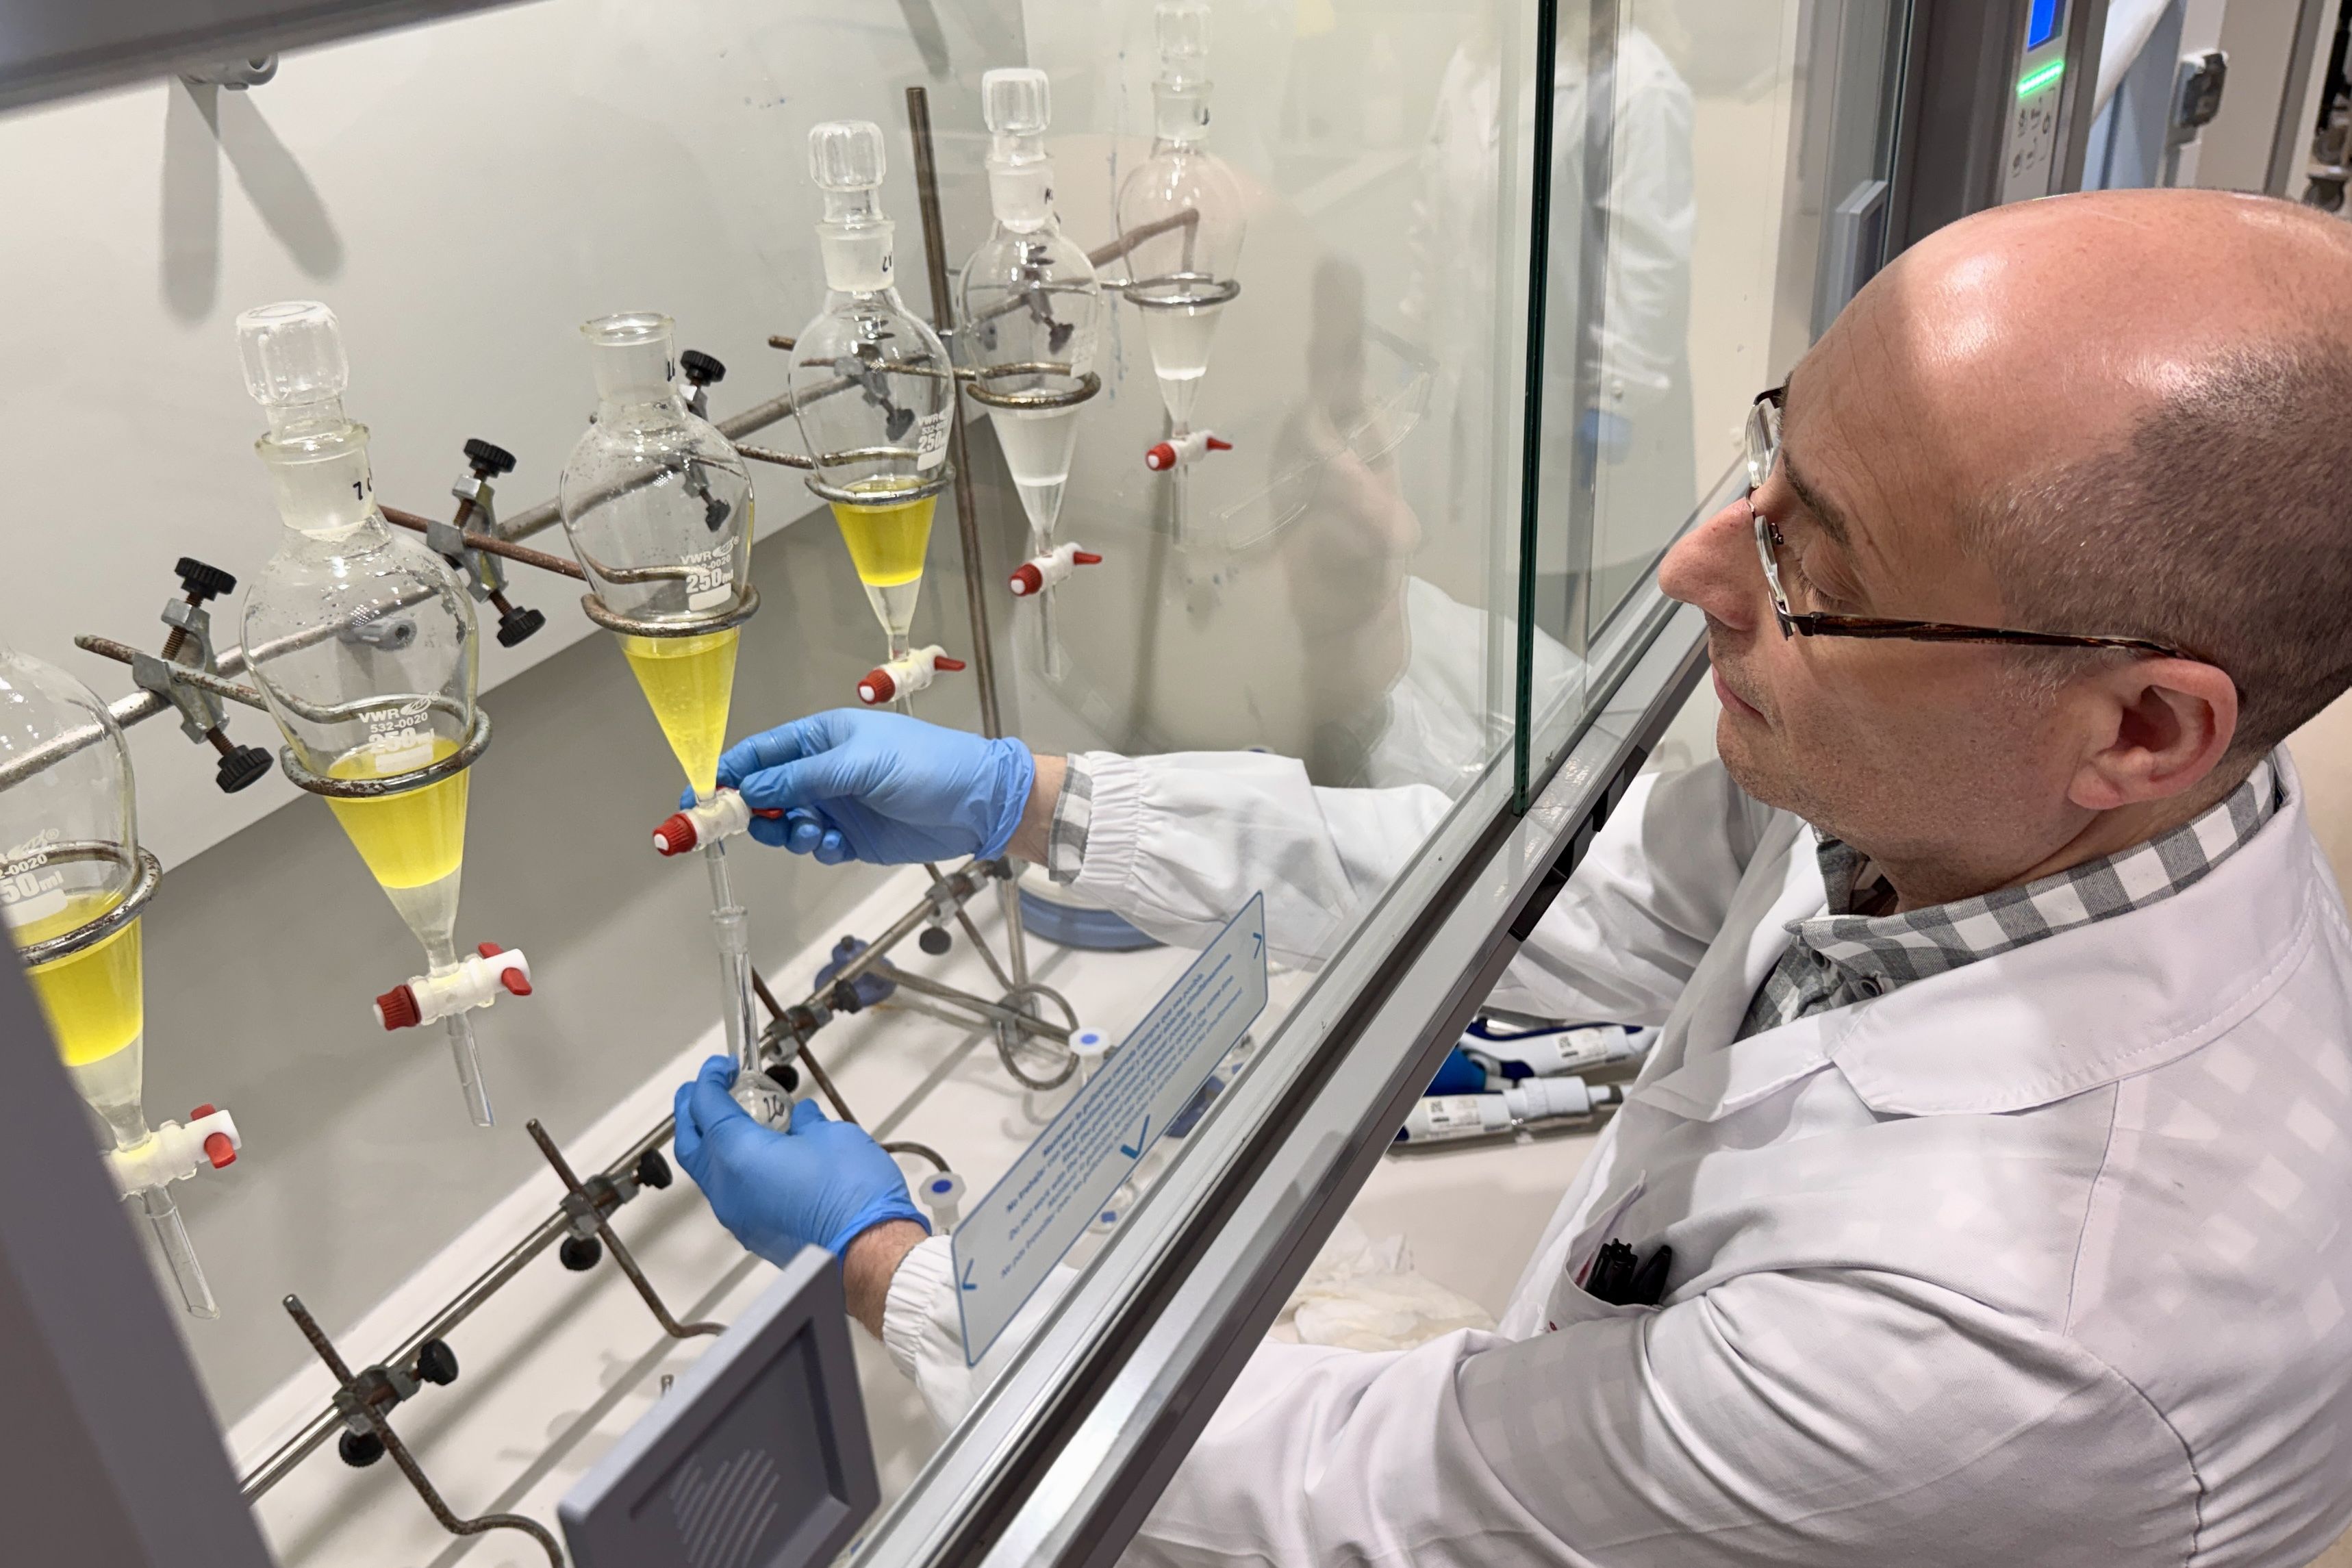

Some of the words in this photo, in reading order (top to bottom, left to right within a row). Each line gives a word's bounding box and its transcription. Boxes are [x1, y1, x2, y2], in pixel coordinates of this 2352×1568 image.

[681, 551, 712, 565] VWR
[685, 568, 734, 594] 250ml
[358, 708, 400, 723] VWR
[370, 711, 429, 733] 532-0020
